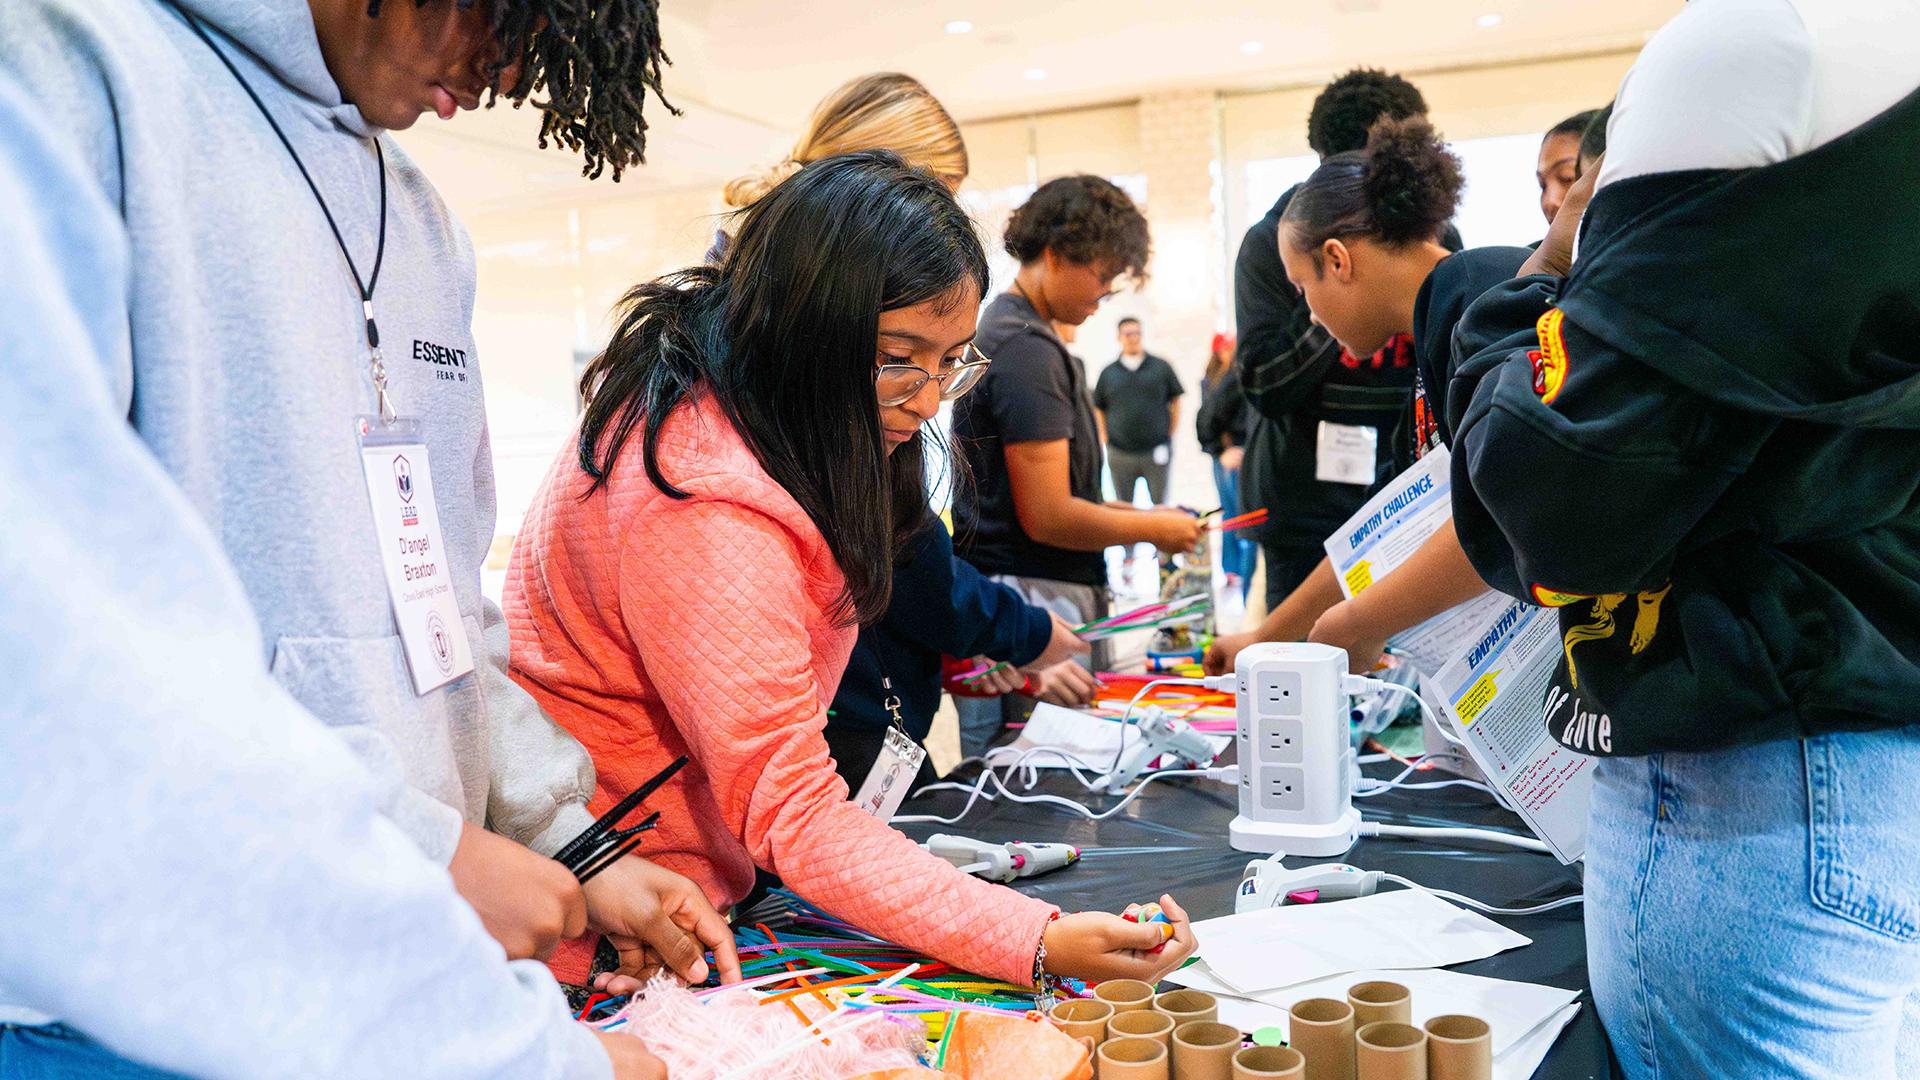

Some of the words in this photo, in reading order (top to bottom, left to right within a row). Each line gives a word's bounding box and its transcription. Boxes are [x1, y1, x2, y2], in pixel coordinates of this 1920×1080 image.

[436, 370, 455, 381] FEAR
[1349, 508, 1383, 549] EMPATHY
[1383, 473, 1434, 519] CHALLENGE
[399, 533, 431, 556] D'angel
[403, 562, 437, 581] Braxton
[1468, 605, 1517, 670] EMPATHY
